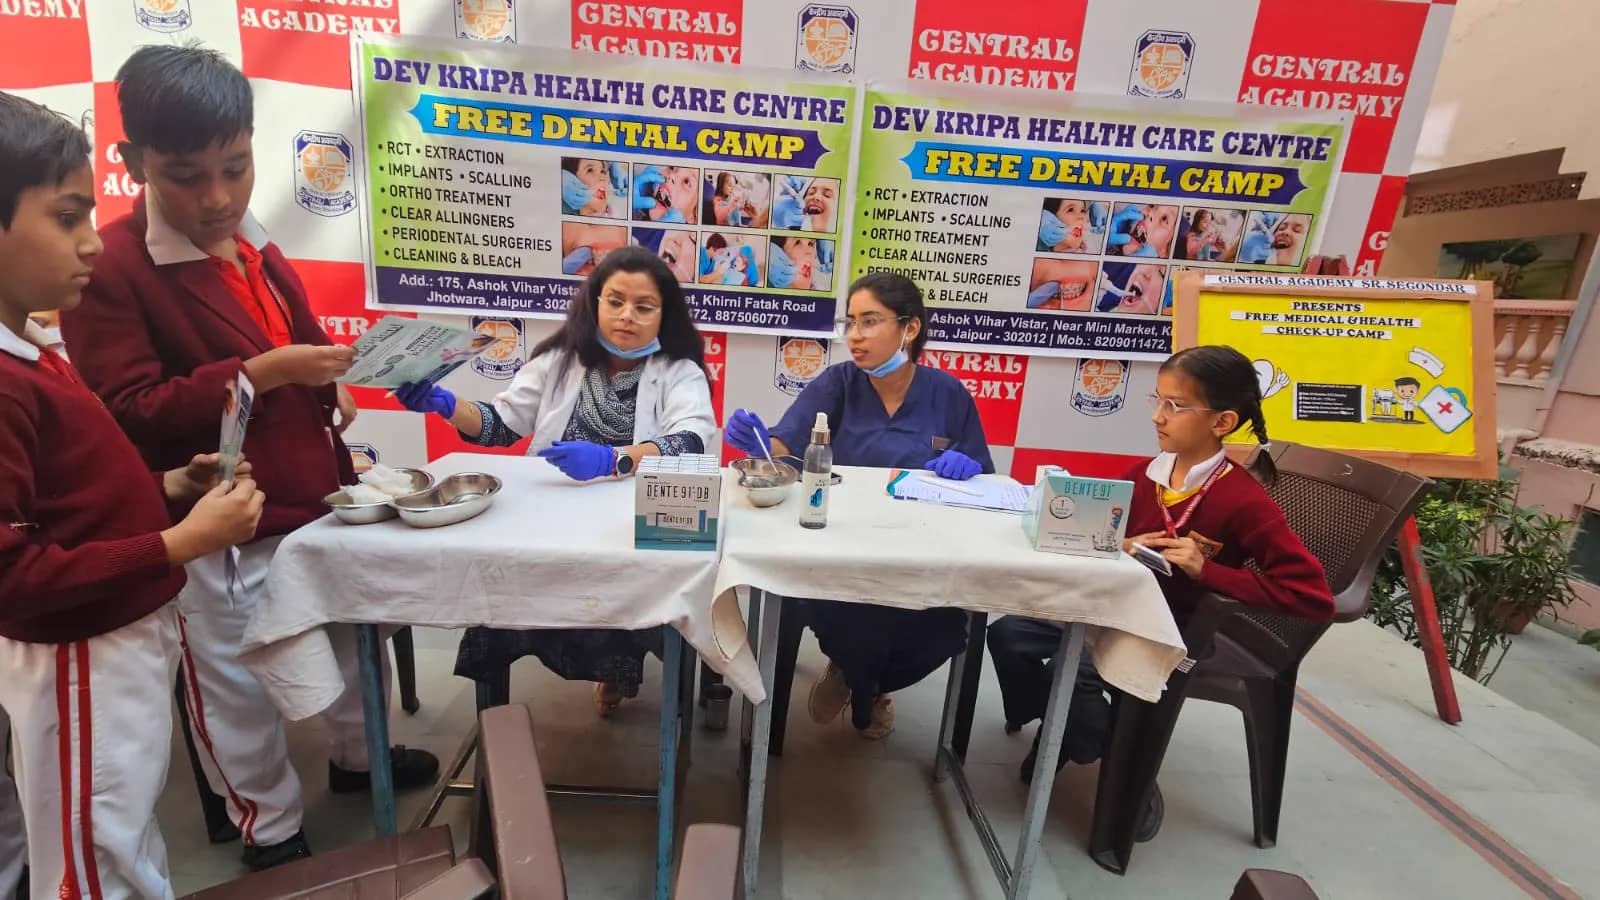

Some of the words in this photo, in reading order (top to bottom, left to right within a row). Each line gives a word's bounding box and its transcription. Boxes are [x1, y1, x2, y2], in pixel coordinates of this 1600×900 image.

[0, 0, 81, 19] DEMY
[578, 2, 737, 36] CENTRAL
[918, 28, 1074, 62] CENTRAL
[1252, 54, 1405, 86] CENTRAL
[373, 57, 431, 86] DEV
[438, 63, 527, 96] KRIPA
[534, 73, 644, 106] HEALTH
[652, 84, 726, 114] CARE
[734, 91, 846, 124] CENTRE
[432, 103, 532, 137] FREE
[542, 113, 688, 152] DENTAL
[696, 128, 804, 160] CAMP
[873, 106, 930, 131] DEV
[934, 110, 1020, 139] KRIPA
[1027, 118, 1136, 148] HEALTH
[1142, 125, 1215, 153] CARE
[1222, 132, 1331, 161] CENTRE
[388, 141, 412, 155] RCT
[425, 145, 504, 165] EXTRACTION
[388, 163, 453, 181] IMPLANTS
[469, 171, 531, 189] SCALLING
[924, 149, 1022, 179] FREE
[1029, 157, 1171, 190] DENTAL
[1180, 167, 1284, 197] CAMP
[390, 184, 432, 200] ORTHO
[435, 189, 511, 208] TREATMENT
[875, 188, 899, 201] RCT
[911, 191, 989, 207] EXTRACTION
[391, 206, 432, 222] CLEAR
[436, 210, 514, 229] ALLINGNERS
[872, 208, 935, 223] IMPLANTS
[950, 213, 1011, 228] SCALLING
[392, 227, 479, 246] PERIODENTAL
[483, 234, 552, 252] SURGERIES
[871, 227, 911, 242] ORTHO
[915, 230, 989, 246] TREATMENT
[394, 248, 457, 265] CLEANING
[460, 251, 469, 265] &
[473, 253, 521, 269] BLEACH
[869, 247, 908, 261] CLEAR
[910, 250, 988, 266] ALLINGNERS
[399, 273, 434, 287] Add.:
[437, 277, 463, 290] 175,
[467, 279, 508, 292] Ashok
[511, 281, 546, 294] Vihar
[548, 283, 580, 296] Vista
[952, 272, 1021, 287] SURGERIES
[427, 290, 489, 307] Jhotwara,
[492, 296, 533, 310] Jaipur
[703, 294, 741, 308] Khirni
[744, 297, 779, 310] Fatak
[783, 300, 816, 313] Road
[927, 288, 936, 300] &
[940, 290, 988, 304] BLEACH
[1293, 301, 1361, 311] PRESENTS
[715, 310, 788, 325] 8875060770
[930, 312, 971, 325] Ashok
[974, 314, 1006, 327] Vihar
[1010, 316, 1050, 332] Vistar,
[1053, 319, 1082, 332] Near
[1085, 321, 1111, 334] Mini
[1114, 322, 1158, 337] Market,
[1245, 312, 1279, 321] FREE
[1284, 314, 1344, 324] MEDICAL
[952, 327, 994, 342] Jaipur
[1003, 330, 1046, 345] 302012
[1056, 335, 1091, 347] Mob.:
[1094, 336, 1167, 351] 8209011472,
[1276, 326, 1343, 337] CHECK-UP
[1347, 328, 1385, 339] CAMP
[917, 351, 1023, 374] NTRAL
